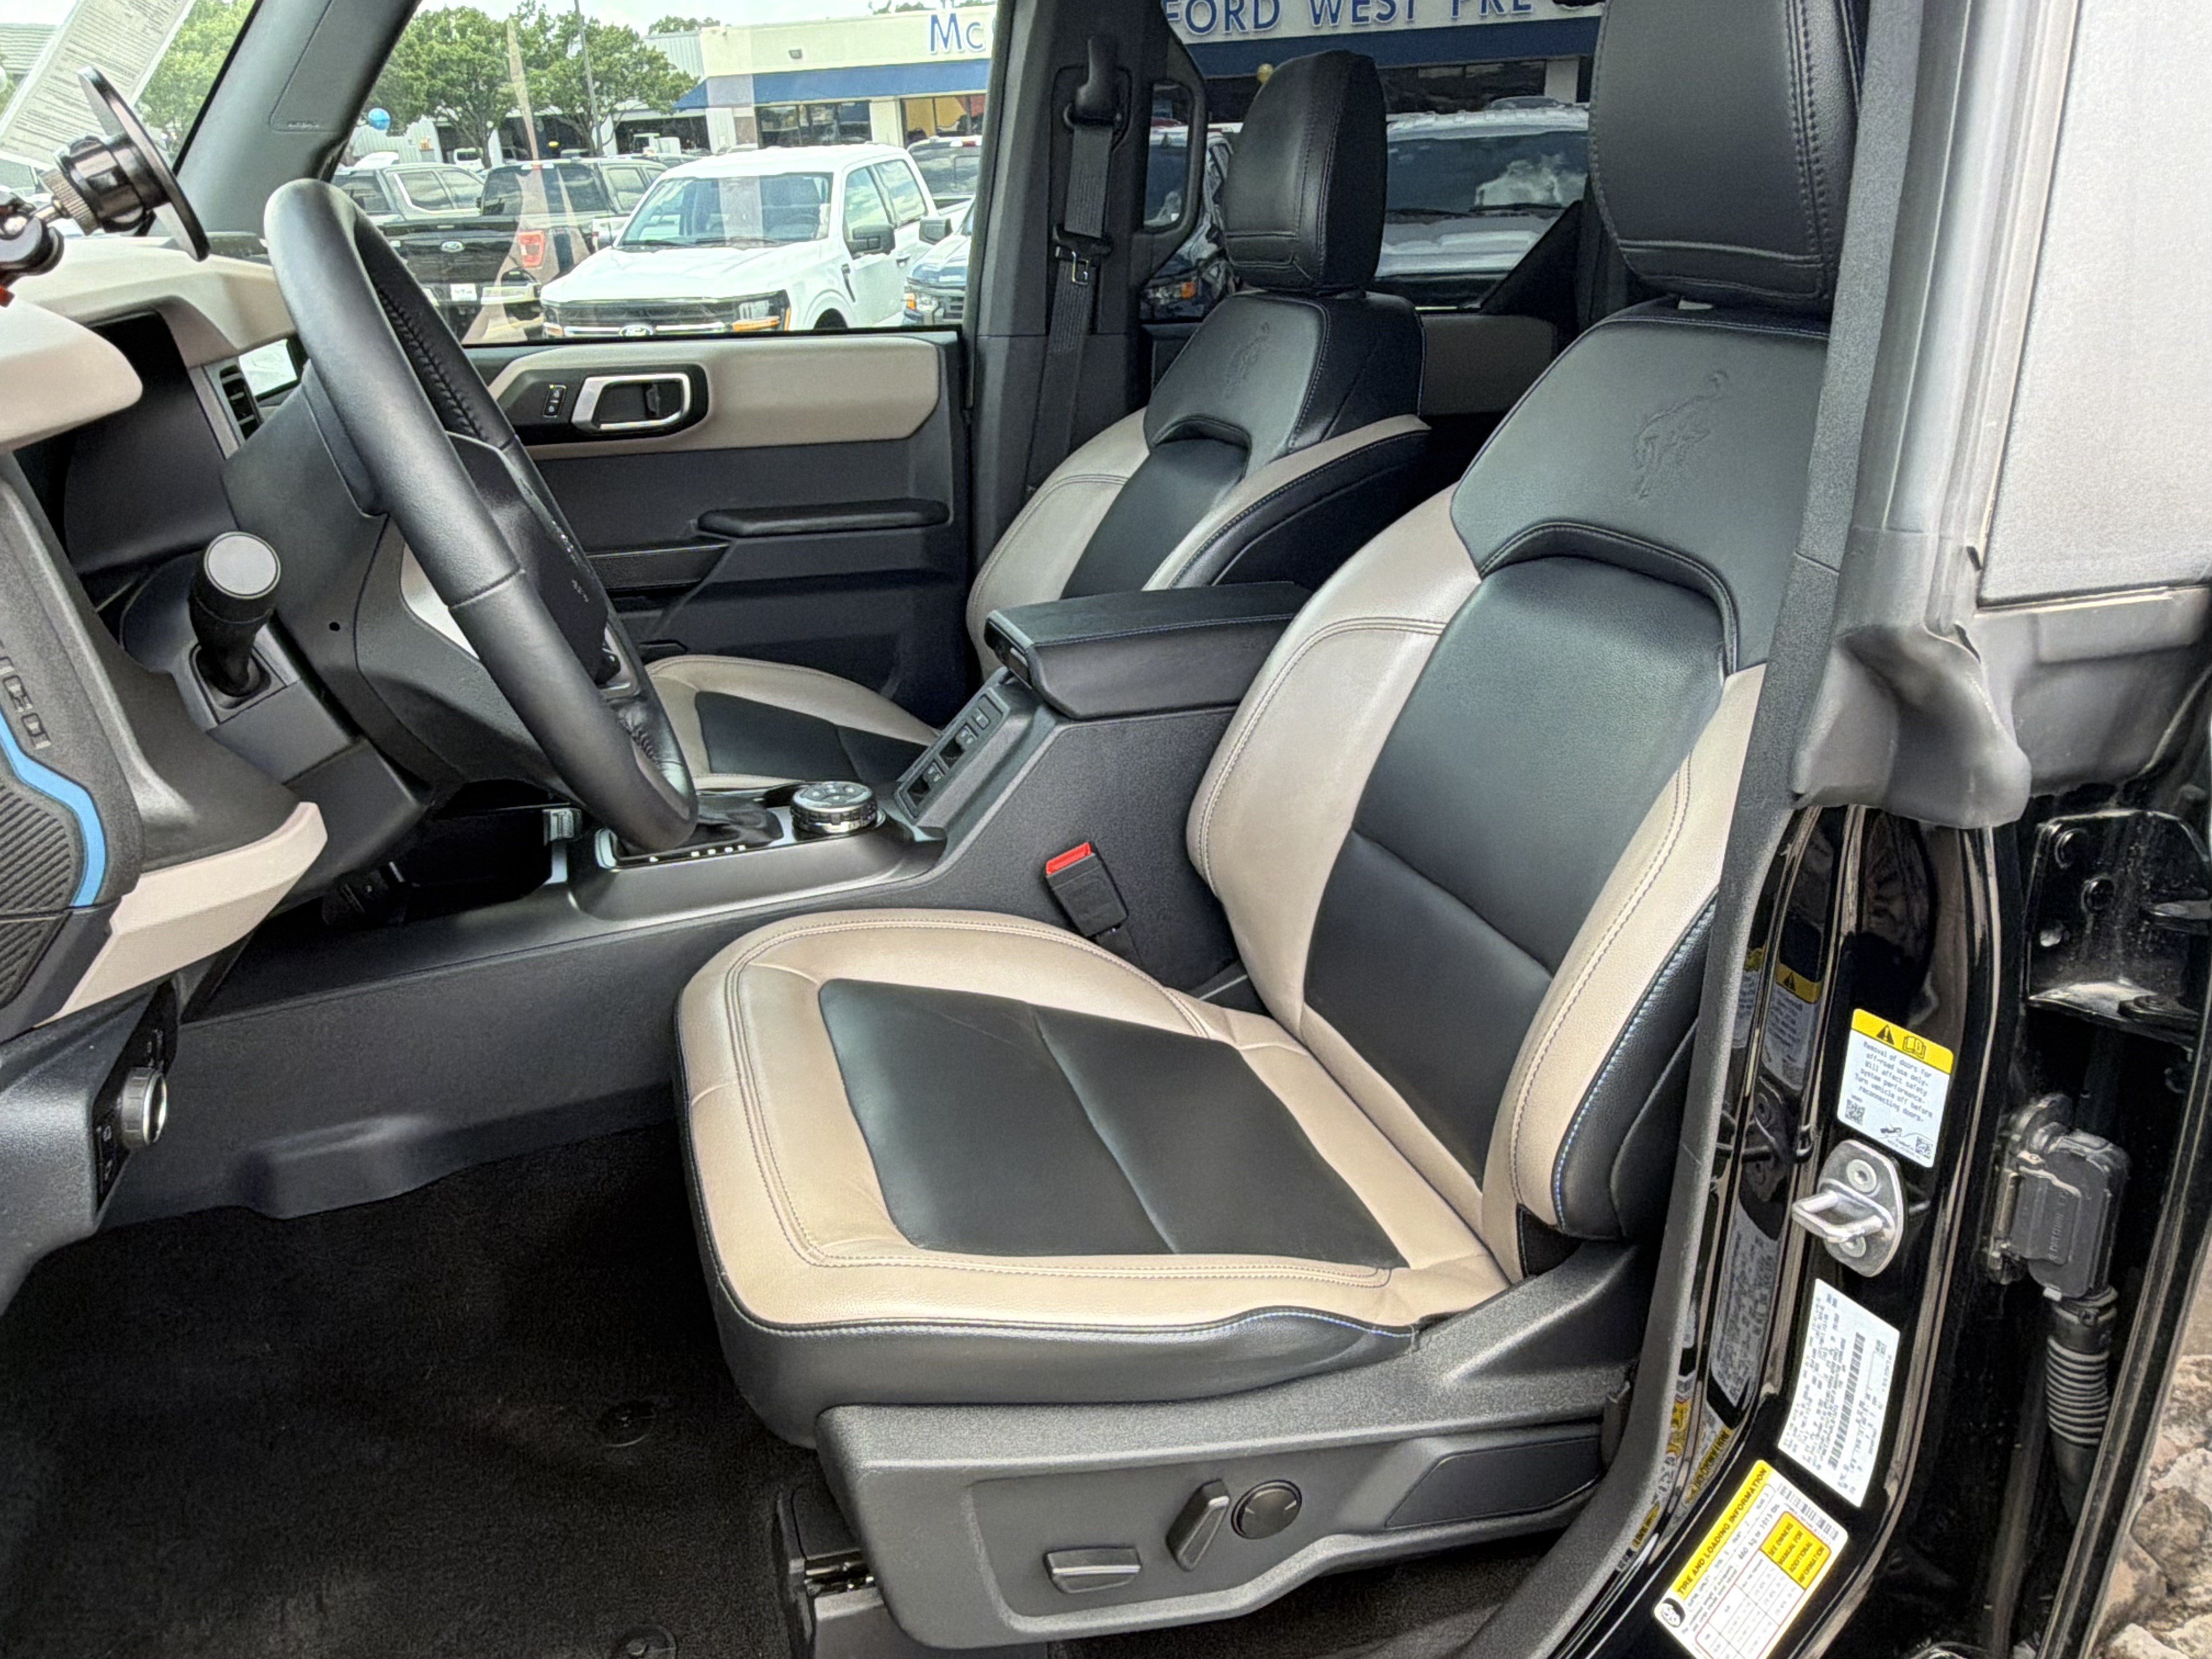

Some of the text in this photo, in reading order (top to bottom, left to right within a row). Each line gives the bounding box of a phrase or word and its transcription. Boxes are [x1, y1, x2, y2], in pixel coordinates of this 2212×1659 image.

[930, 13, 984, 52] Mc
[1676, 1574, 1694, 1596] TIRE
[1690, 1556, 1706, 1576] AND
[1702, 1522, 1731, 1559] LOADING
[1726, 1466, 1769, 1523] INFORMATION
